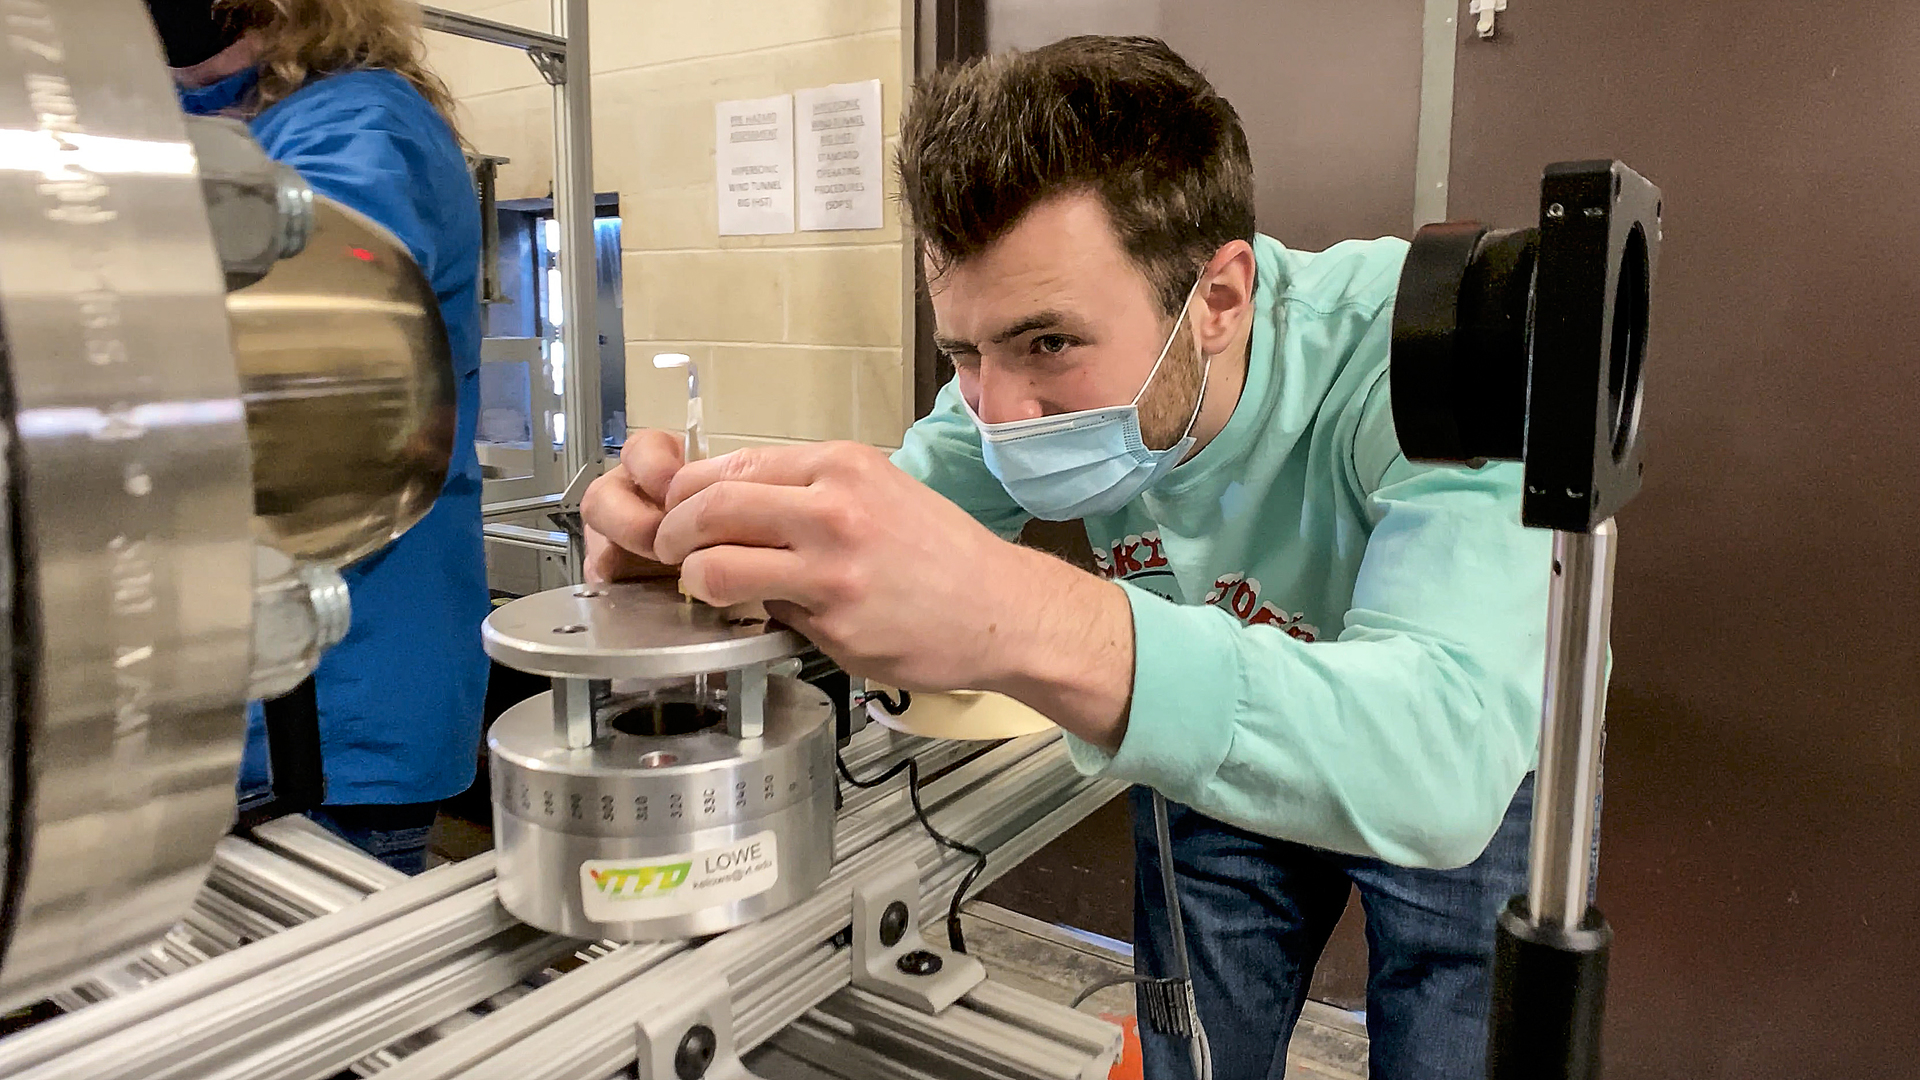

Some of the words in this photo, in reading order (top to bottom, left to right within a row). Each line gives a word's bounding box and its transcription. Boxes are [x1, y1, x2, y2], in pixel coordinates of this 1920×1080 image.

[817, 150, 860, 162] STANDARD
[816, 166, 861, 179] OPERATING
[751, 180, 782, 191] TUNNEL
[814, 182, 865, 194] PROCEDURES
[735, 780, 747, 808] 340
[764, 774, 775, 802] 350
[670, 792, 683, 819] 320
[704, 842, 762, 874] LOWE
